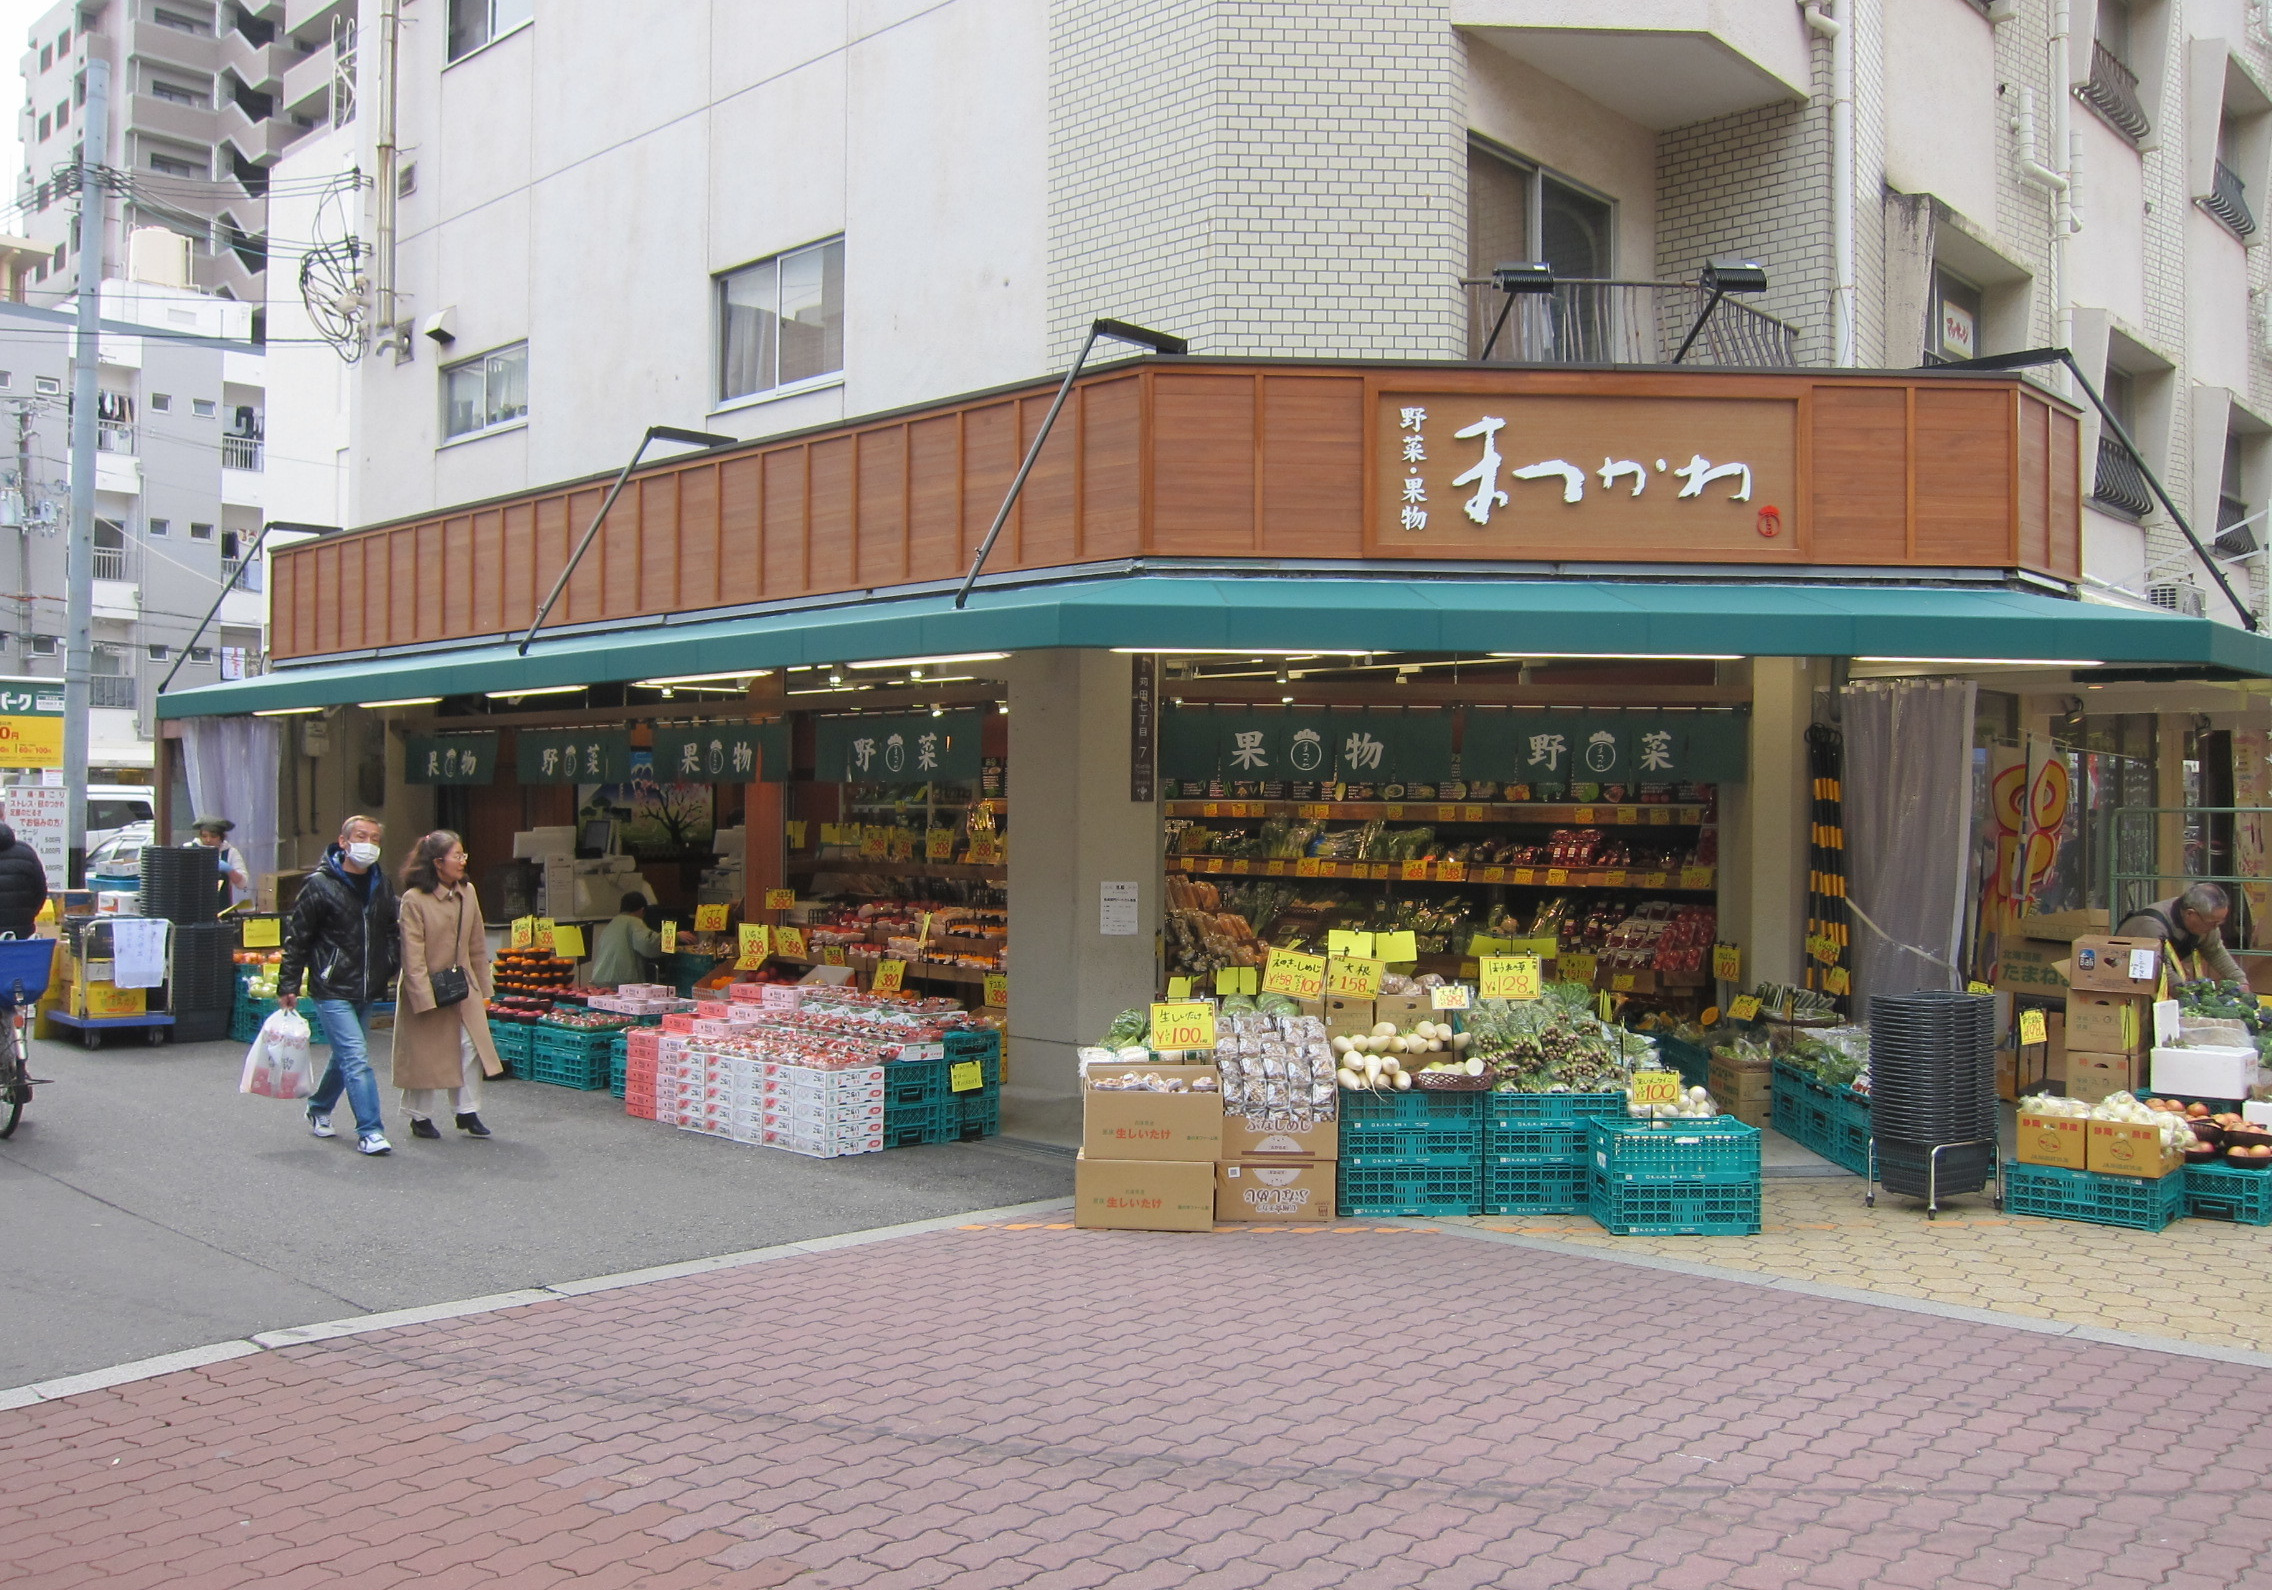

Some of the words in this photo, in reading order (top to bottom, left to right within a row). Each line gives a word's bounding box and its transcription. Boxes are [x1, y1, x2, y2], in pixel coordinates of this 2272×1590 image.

[1400, 407, 1427, 531] 野菜・果物
[427, 750, 477, 778] 果物
[541, 744, 600, 776] 野菜
[682, 741, 752, 775] 果物
[853, 732, 938, 772] 野菜
[1229, 731, 1384, 771] 果物
[1527, 731, 1674, 772] 野菜
[1116, 1127, 1172, 1140] 生しいたけ
[1106, 1197, 1163, 1209] 生しいたけ
